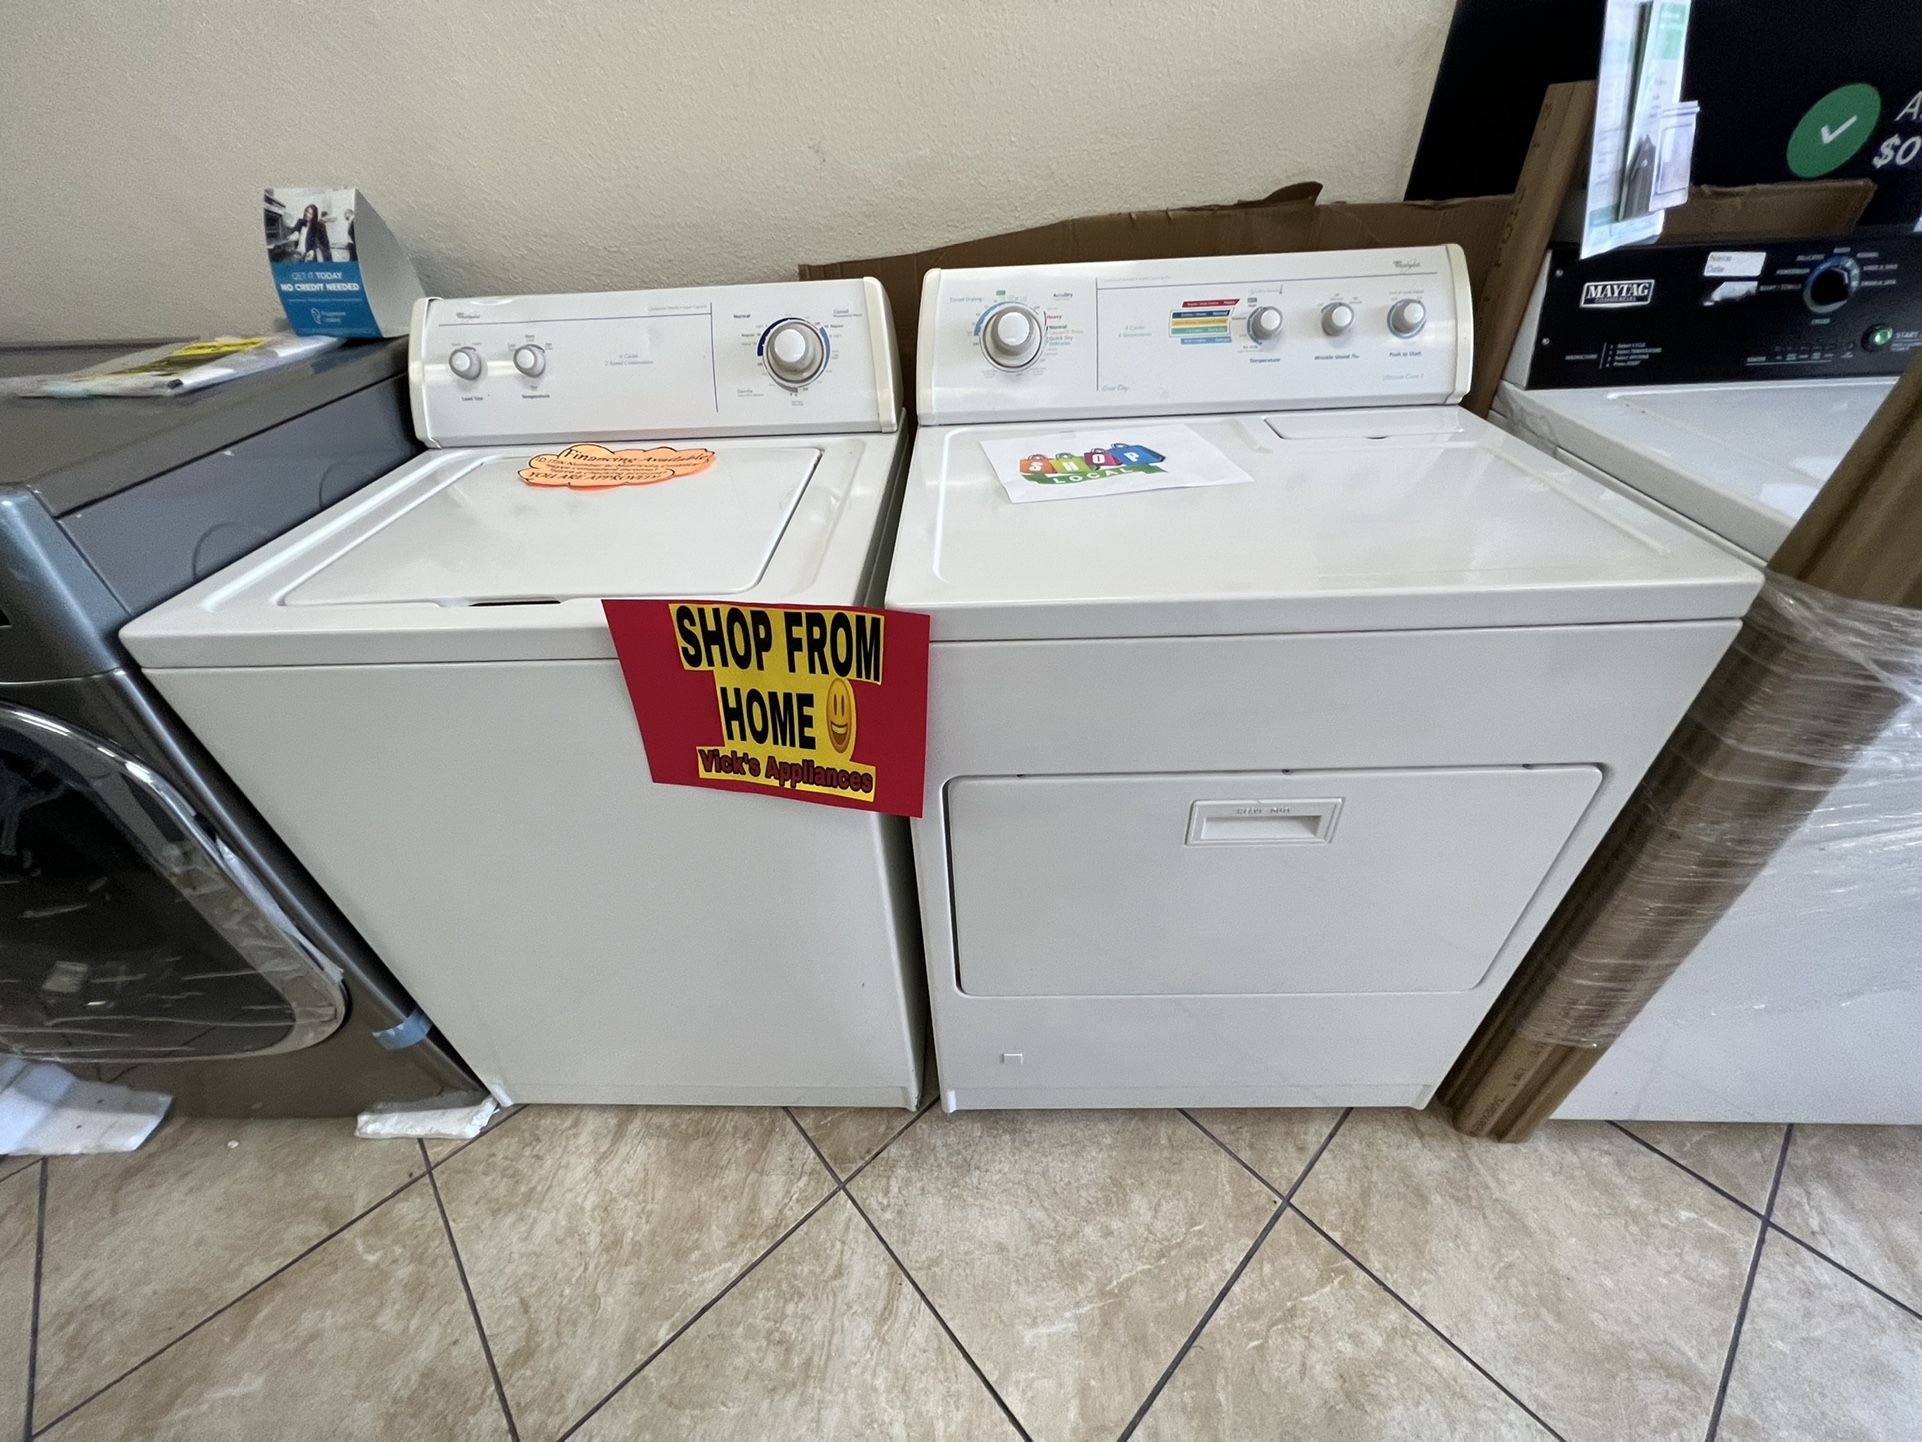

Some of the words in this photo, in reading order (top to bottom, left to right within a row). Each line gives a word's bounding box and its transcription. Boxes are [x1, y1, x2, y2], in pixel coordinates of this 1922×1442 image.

[1894, 90, 1922, 121] A
[315, 271, 342, 280] TODAY
[280, 283, 294, 291] NO
[296, 283, 324, 291] CREDIT
[326, 283, 360, 291] NEEDED
[1586, 283, 1649, 298] MAYTAG
[564, 449, 637, 464] Financing
[1028, 451, 1140, 473] SHOP
[1053, 466, 1134, 485] LOCAL
[675, 605, 773, 671] SHOP
[783, 611, 882, 683] FROM
[720, 686, 817, 750] HOME
[698, 749, 761, 778] Vick's
[764, 755, 874, 794] Appliances
